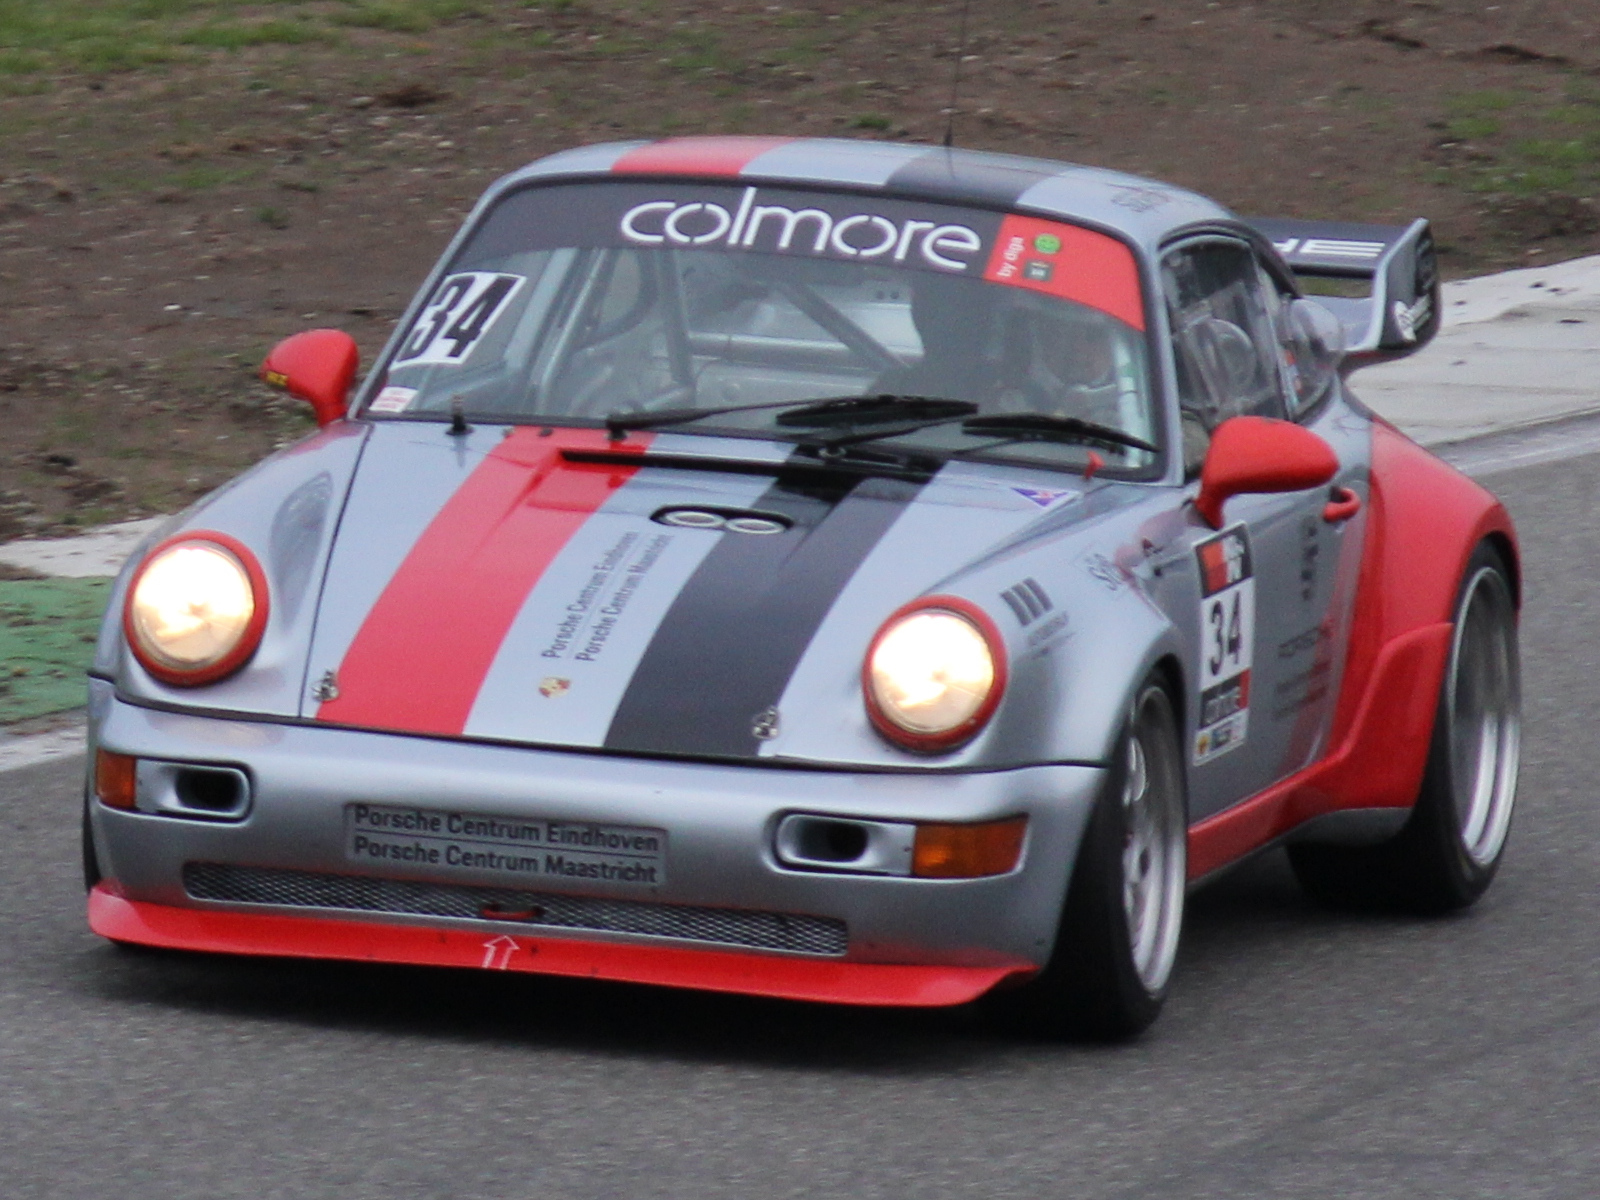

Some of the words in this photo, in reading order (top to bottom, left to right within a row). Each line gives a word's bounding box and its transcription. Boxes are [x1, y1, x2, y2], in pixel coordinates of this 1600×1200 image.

[620, 186, 982, 270] colmore
[396, 274, 520, 363] 34
[541, 613, 584, 659] Porsche
[566, 572, 609, 613] Centrum
[574, 616, 618, 661] Porsche
[600, 574, 645, 615] Centrum
[1208, 590, 1242, 676] 34
[353, 836, 440, 865] Porsche
[445, 844, 539, 873] Centrum
[544, 854, 657, 884] Maastricht
[354, 804, 441, 832] Porsche
[447, 813, 541, 842] Centrum
[547, 823, 660, 852] Eindhoven
